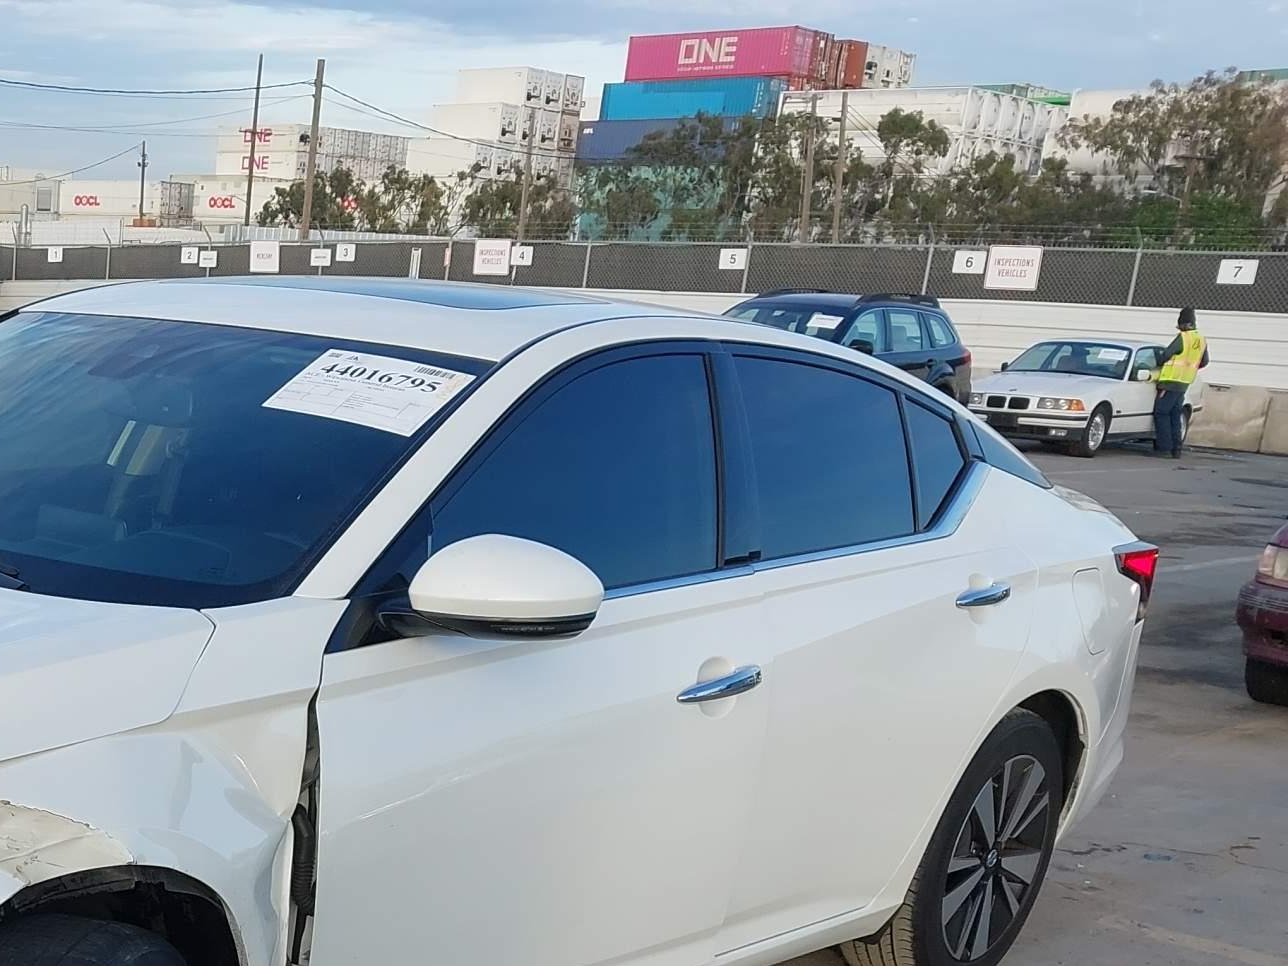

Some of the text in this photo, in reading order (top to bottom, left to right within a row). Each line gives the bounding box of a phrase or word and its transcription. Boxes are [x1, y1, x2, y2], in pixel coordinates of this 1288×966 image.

[678, 36, 738, 64] ONE
[74, 194, 101, 207] OOCL
[208, 196, 235, 208] OOCL
[187, 251, 192, 259] 2
[343, 248, 349, 257] 3
[519, 251, 525, 260] 4
[729, 254, 737, 265] 5
[965, 256, 974, 268] 6
[994, 258, 1035, 267] INSPECTIONS
[997, 269, 1028, 278] VEHICLES
[1234, 266, 1243, 278] 7
[321, 363, 443, 393] 44016795
